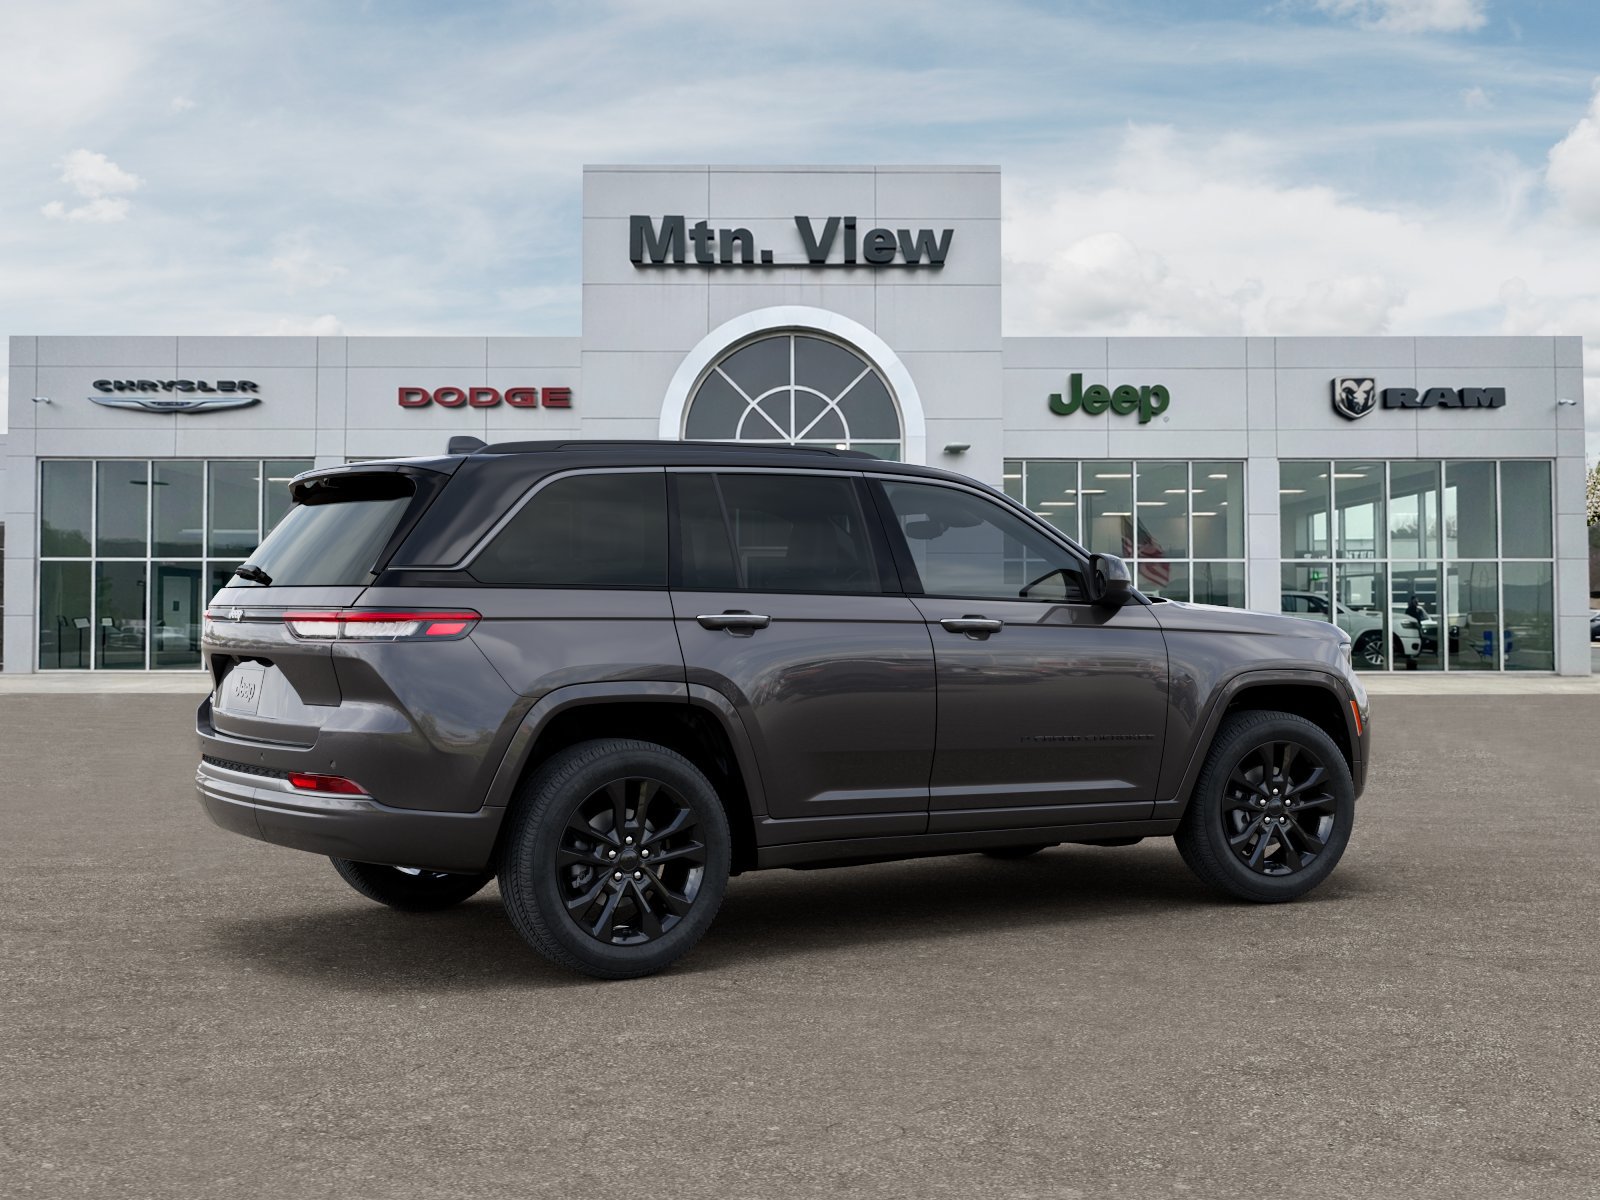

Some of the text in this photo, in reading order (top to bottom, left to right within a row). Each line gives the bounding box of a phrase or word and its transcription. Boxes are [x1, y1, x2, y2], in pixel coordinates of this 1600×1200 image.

[630, 215, 954, 266] Mtn. View
[92, 379, 259, 393] CHRYSLER
[398, 387, 572, 408] DODGE
[1380, 387, 1506, 409] RAM
[1048, 373, 1170, 424] Jeep
[235, 676, 256, 703] Jeep
